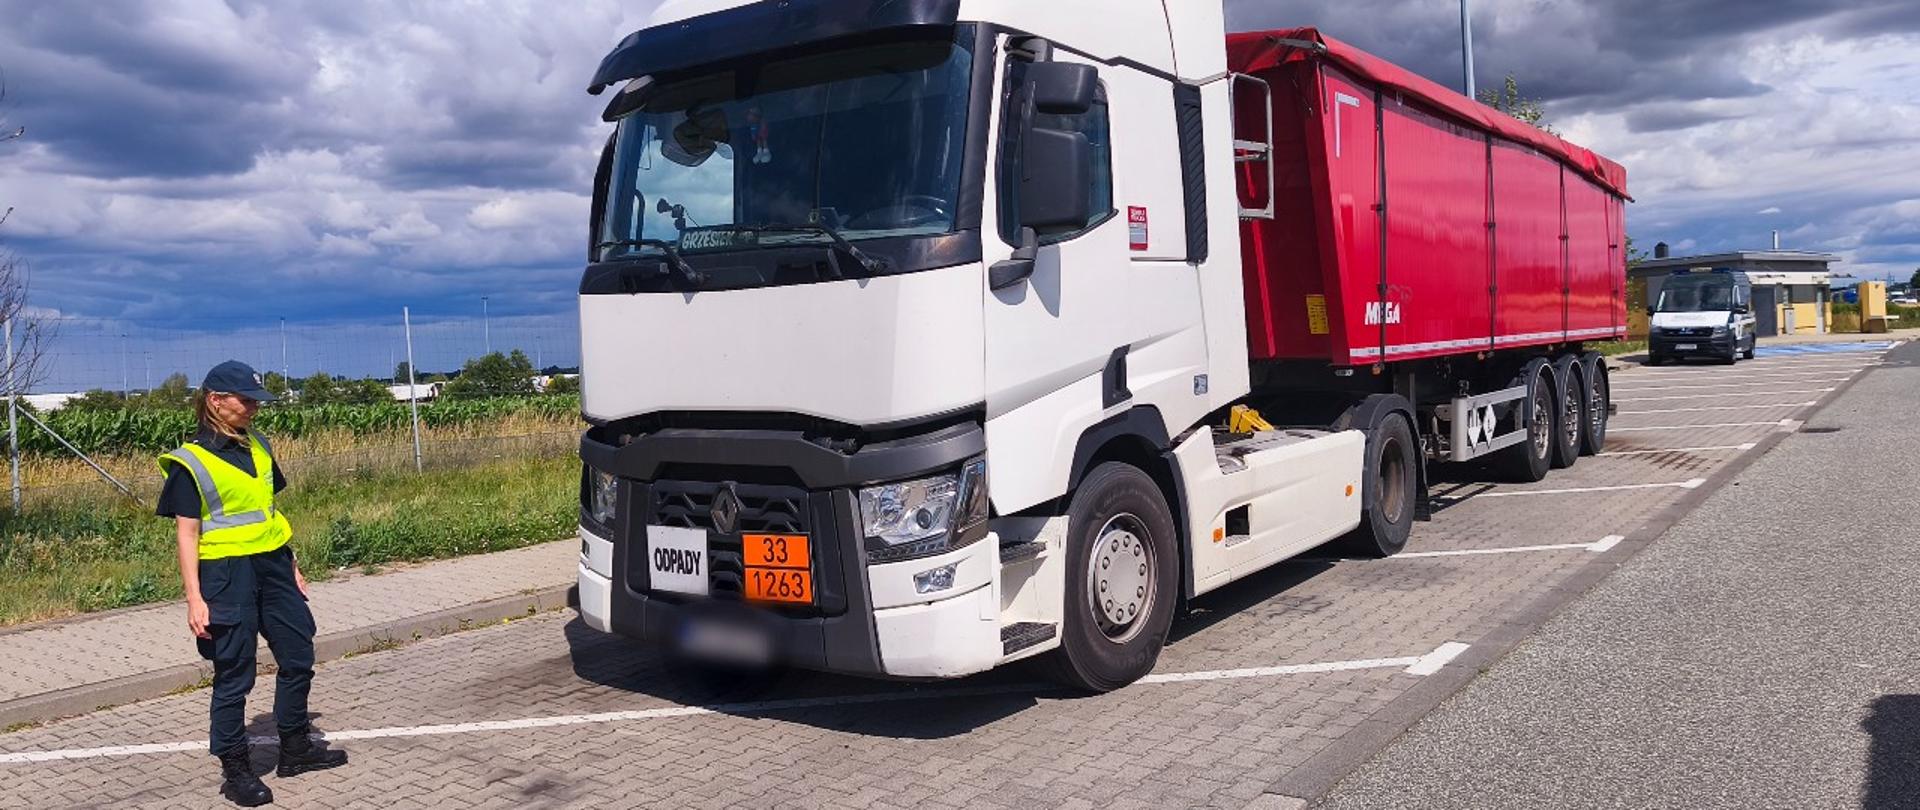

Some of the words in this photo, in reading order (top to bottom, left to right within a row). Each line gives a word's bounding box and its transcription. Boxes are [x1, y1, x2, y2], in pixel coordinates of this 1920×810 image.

[654, 547, 701, 576] ODPADY
[762, 537, 789, 563] 33
[753, 571, 804, 598] 1263
